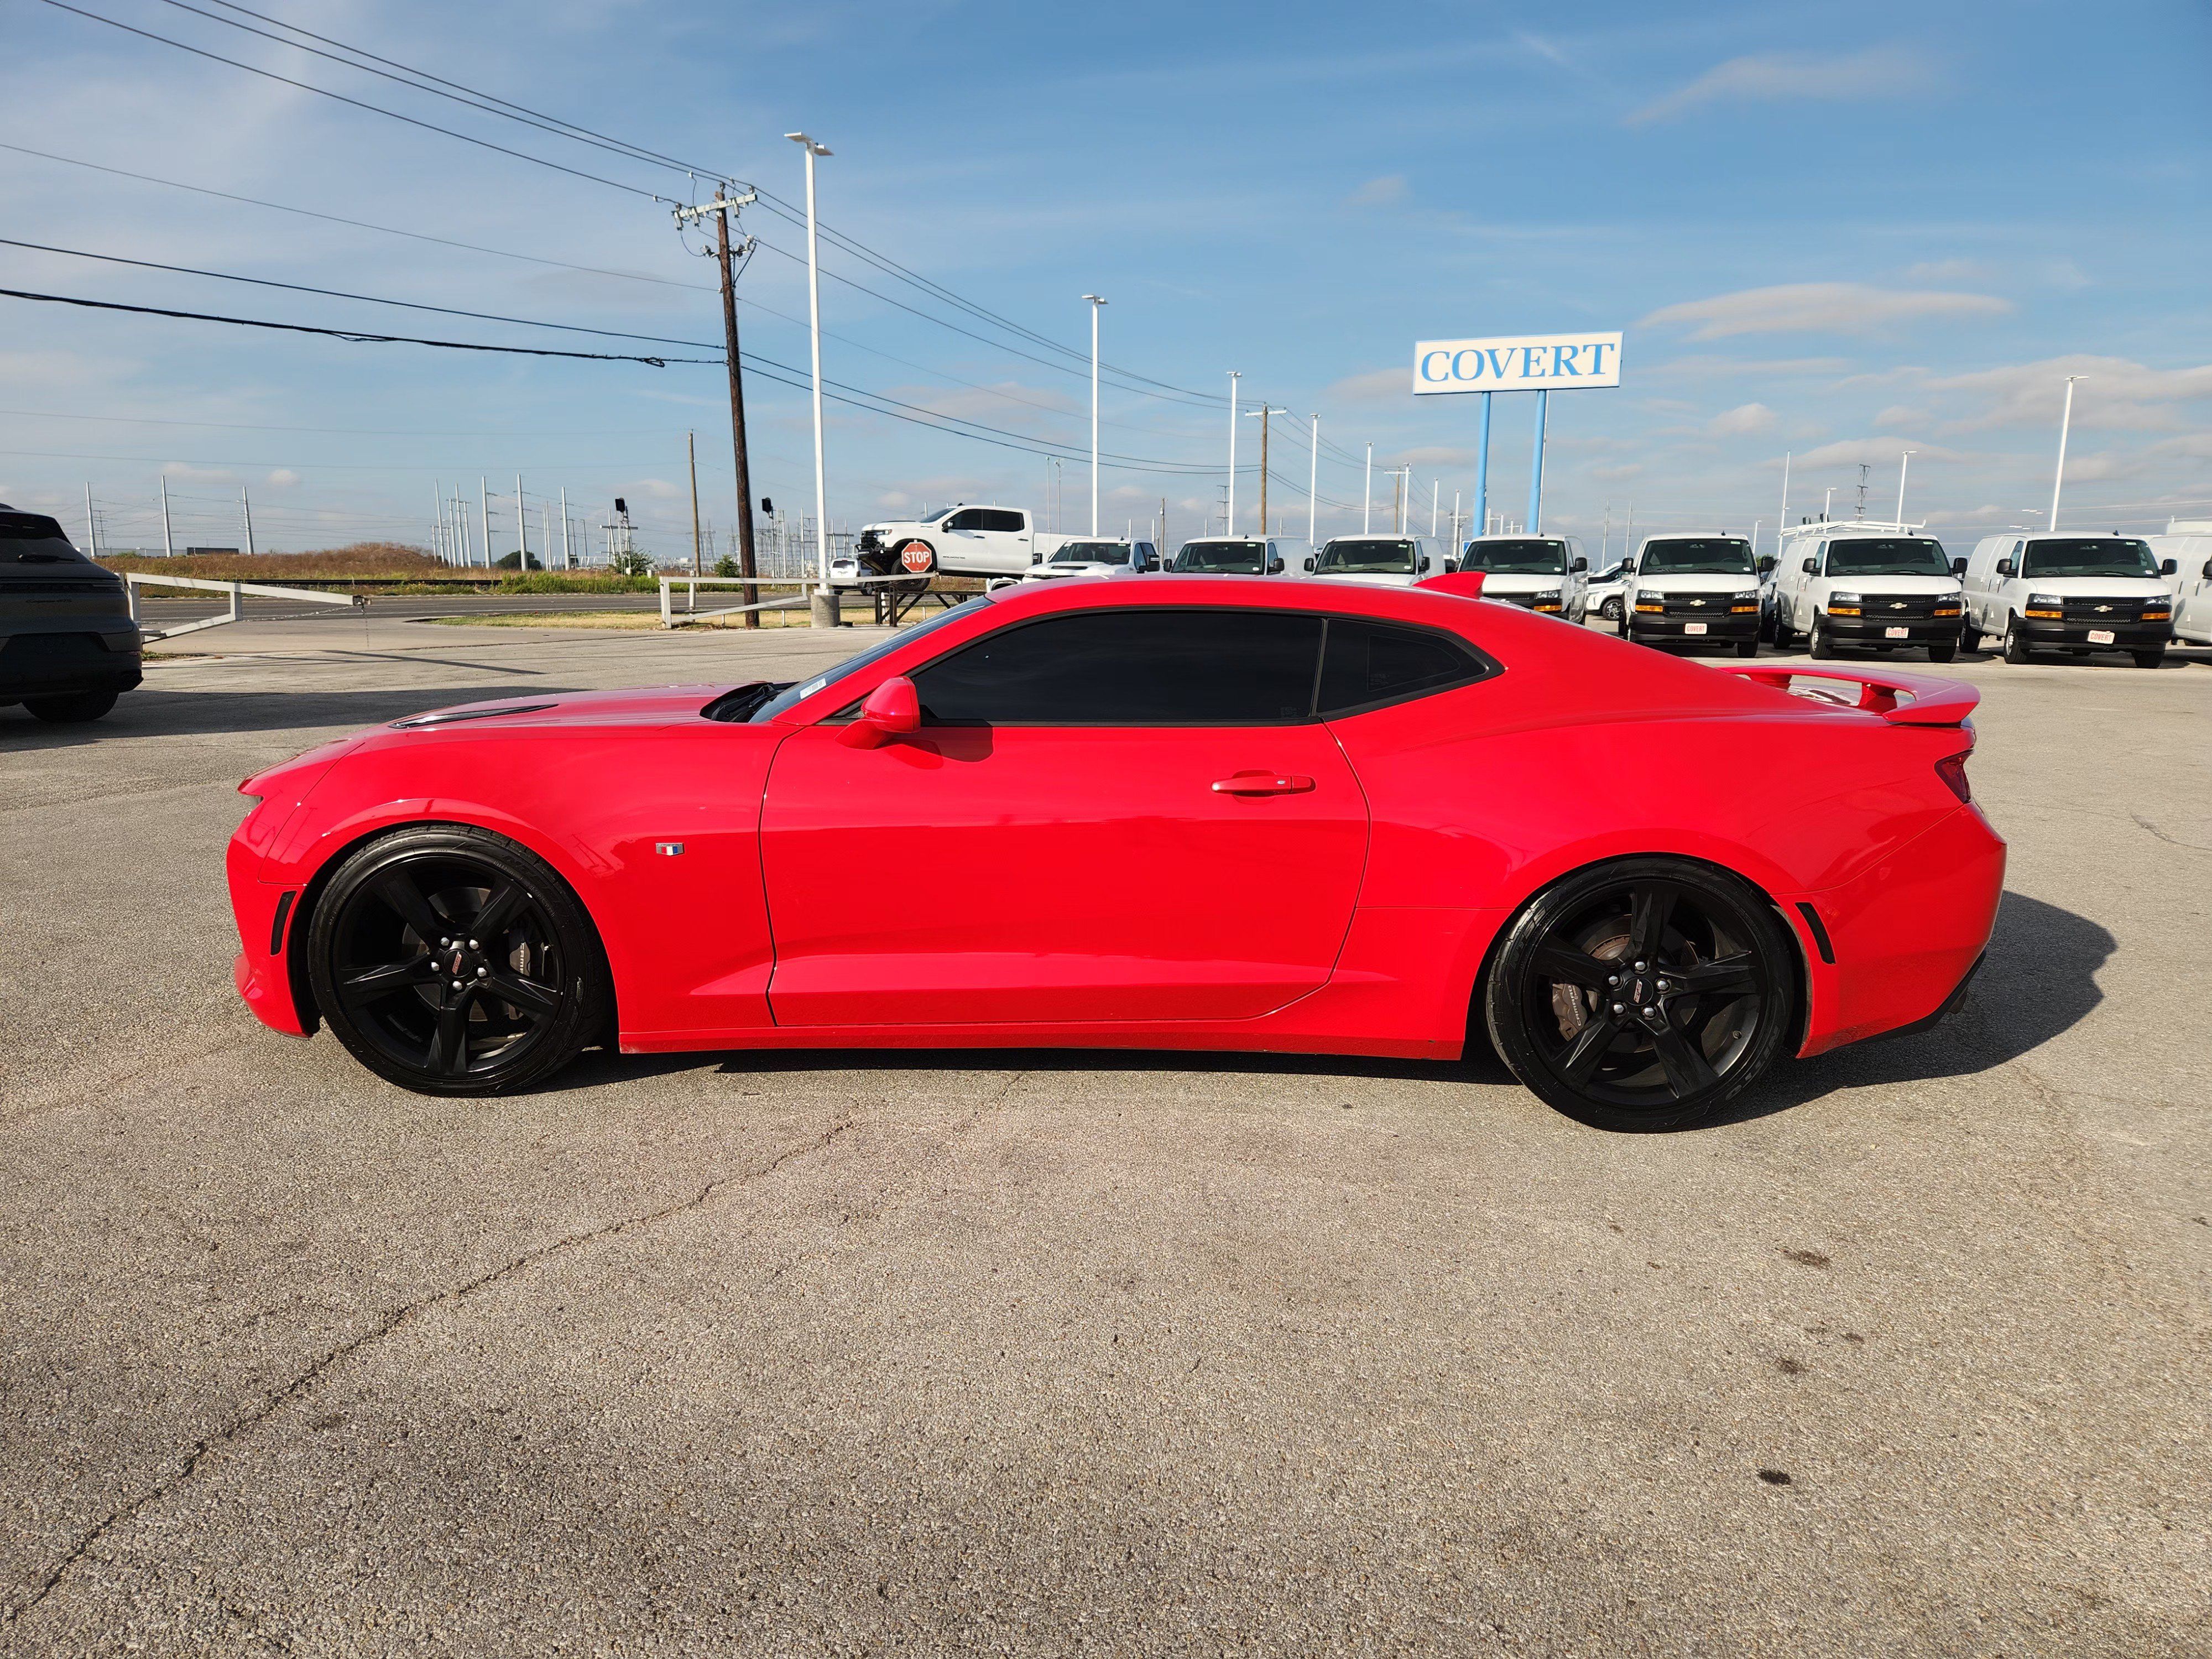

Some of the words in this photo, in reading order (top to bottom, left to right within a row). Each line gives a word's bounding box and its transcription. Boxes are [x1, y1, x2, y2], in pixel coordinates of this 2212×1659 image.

[1421, 343, 1615, 382] COVERT
[904, 551, 930, 564] STOP
[2090, 633, 2112, 641] COVERT
[1568, 985, 1582, 1026] CAMARO
